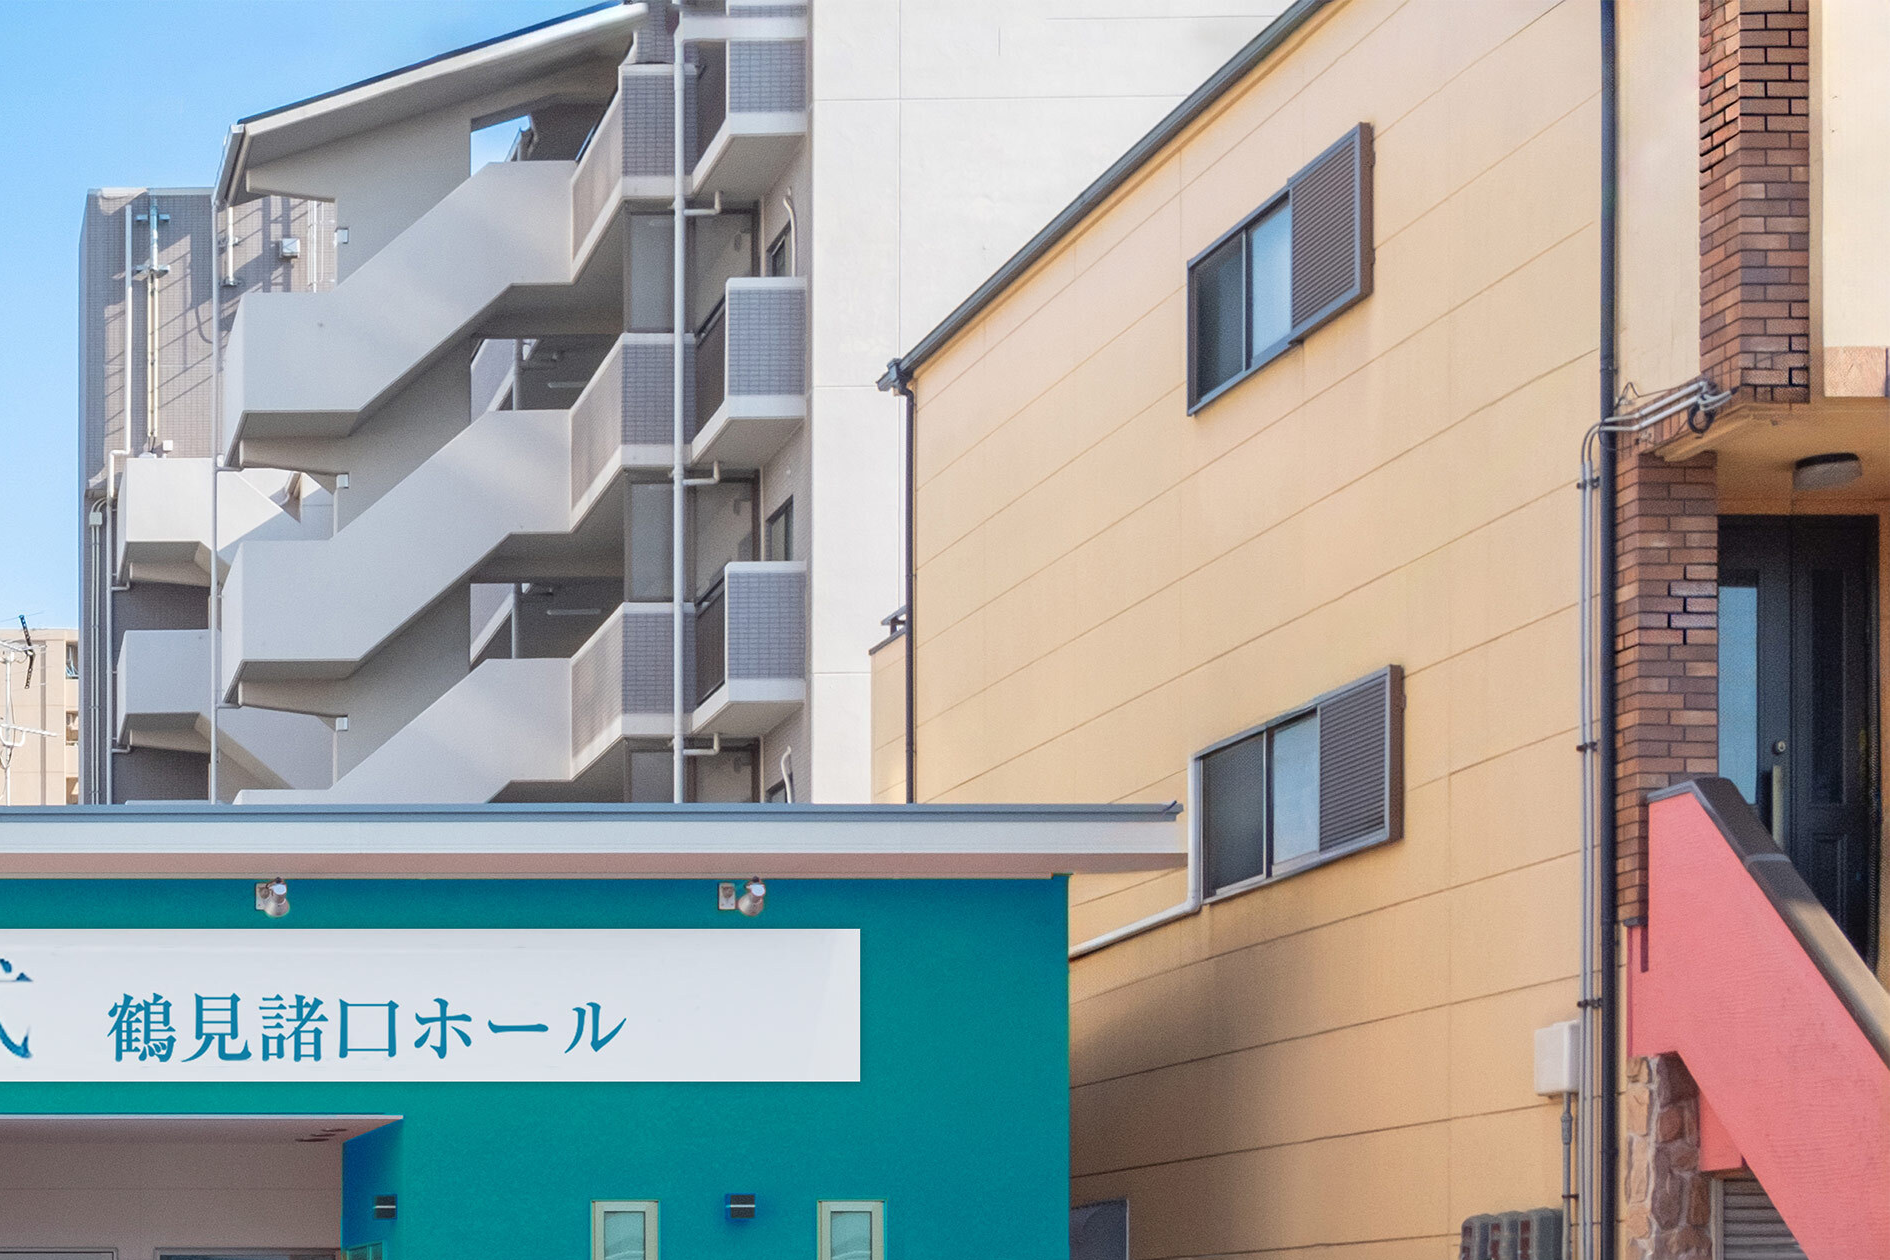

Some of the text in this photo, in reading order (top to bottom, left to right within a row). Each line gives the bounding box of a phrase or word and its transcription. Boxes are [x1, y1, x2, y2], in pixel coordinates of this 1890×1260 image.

[106, 992, 627, 1063] 鶴見諸口ホール
